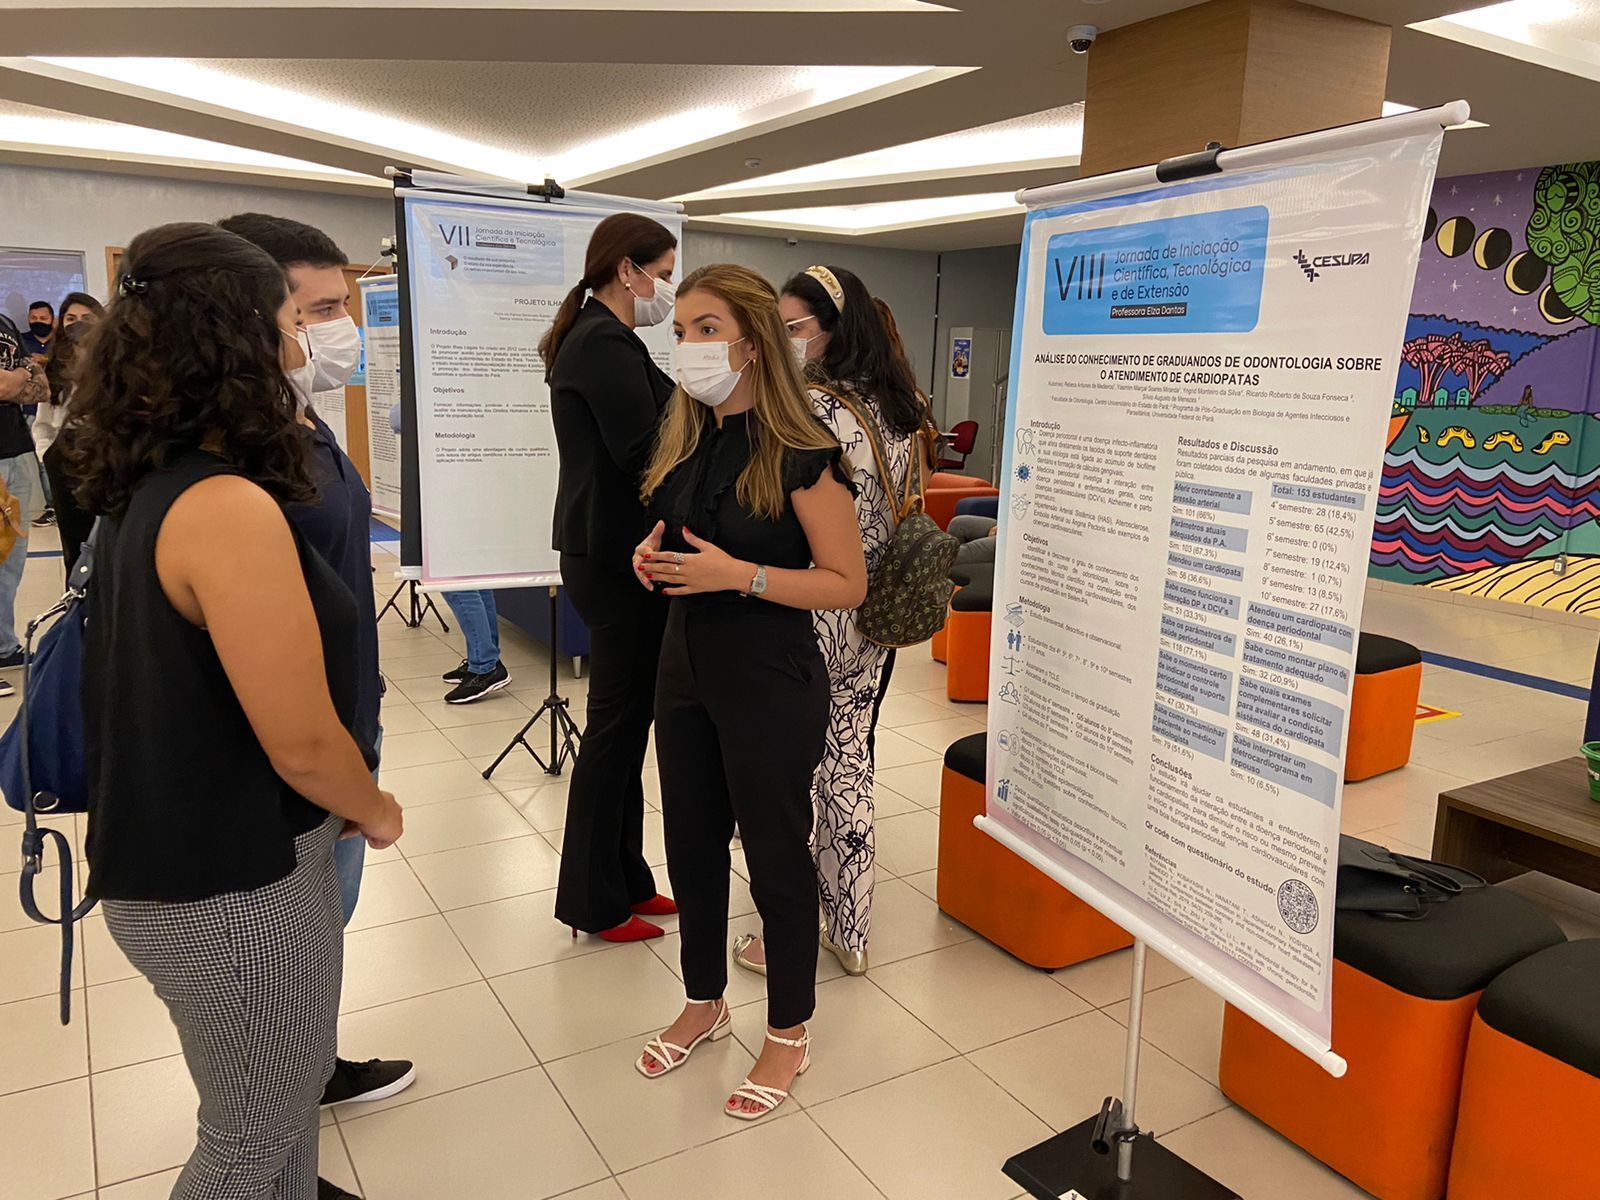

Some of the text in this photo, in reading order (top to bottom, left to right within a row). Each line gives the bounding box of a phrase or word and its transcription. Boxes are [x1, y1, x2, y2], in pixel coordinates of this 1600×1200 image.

[438, 224, 470, 247] VII
[475, 227, 503, 236] Jornada
[514, 229, 545, 239] Iniciação
[475, 234, 509, 243] Científica
[516, 237, 556, 247] Tecnológica
[1115, 238, 1240, 267] Jornada de Iniciação
[1312, 251, 1370, 267] CESUPA
[1173, 258, 1251, 278] Tecnológica
[1056, 254, 1104, 300] VIII
[1121, 286, 1134, 300] de
[1138, 283, 1189, 299] Extensão
[514, 298, 546, 306] PROJETO
[1112, 308, 1146, 316] Professora
[1161, 306, 1185, 315] Dantas
[430, 328, 467, 336] Introdução
[1035, 353, 1382, 371] ANÁLISE DO CONHECIMENTO DE GRADUANDOS DE ODONTOLOGIA SOBRE
[1108, 370, 1168, 382] ATENDIMENTO
[1170, 372, 1182, 383] DE
[1184, 373, 1259, 386] CARDIOPATAS
[432, 386, 465, 394] Objetivos
[1246, 390, 1268, 398] Ricardo
[1269, 391, 1292, 399] Roberto
[1302, 392, 1321, 400] Souza
[1322, 393, 1349, 402] Fonseca
[1252, 409, 1344, 422] Biologia de Agentes Infecciosos
[1031, 420, 1060, 430] Introdução
[435, 432, 476, 440] Metodologia
[1178, 436, 1220, 449] Resultados
[1230, 441, 1278, 455] Discussão
[1209, 453, 1235, 462] parciais
[1236, 455, 1245, 464] da
[1247, 458, 1278, 467] pesquisa
[1354, 469, 1367, 478] que
[1224, 465, 1245, 475] dados
[1248, 468, 1257, 477] de
[1260, 470, 1290, 480] algumas
[1293, 473, 1333, 486] faculdades
[1336, 480, 1366, 490] privadas
[1273, 485, 1355, 504] Total: 153 estudantes
[1279, 504, 1314, 515] semestre:
[1316, 507, 1326, 517] 28
[1277, 520, 1312, 531] semestre:
[1314, 524, 1324, 533] 65
[1023, 533, 1048, 546] Objetivos
[1275, 536, 1310, 548] semestre:
[1273, 551, 1308, 564] semestre:
[1312, 557, 1321, 567] 19
[1271, 566, 1306, 578] semestre:
[1269, 580, 1304, 593] semestre:
[1308, 587, 1317, 596] 13
[1019, 596, 1050, 613] Metodologia
[1272, 596, 1307, 609] semestre:
[1309, 602, 1320, 612] 27
[1247, 616, 1321, 640] doença periodontal
[1248, 604, 1352, 639] Atendeu um cardiopata com
[1246, 628, 1261, 638] Sim:
[1263, 633, 1273, 642] 40
[1243, 653, 1324, 682] tratamento adequado
[1244, 639, 1348, 680] Sabe como montar plano de
[1242, 665, 1257, 676] Sim:
[1259, 670, 1269, 680] 32
[1240, 677, 1311, 707] Sabe quais exames
[1238, 689, 1332, 726] complementares solicitar
[1237, 698, 1253, 711] para
[1255, 707, 1280, 720] avaliar
[1288, 719, 1323, 735] condição
[1235, 722, 1249, 734] Sim:
[1251, 729, 1261, 738] 48
[1236, 712, 1324, 748] sistêmica do cardiopata
[1233, 733, 1306, 769] Sabe interpretar um
[1151, 754, 1192, 780] Conclusões
[1231, 758, 1260, 774] repouso
[1232, 746, 1312, 783] eletrocardiograma em
[1230, 769, 1244, 781] Sim:
[1247, 776, 1256, 785] 10
[1278, 824, 1320, 848] entenderem
[1154, 827, 1170, 840] code
[1171, 836, 1186, 848] com
[1187, 845, 1233, 872] questionário
[1234, 868, 1245, 879] do
[1246, 876, 1276, 896] estudo:
[1221, 831, 1325, 888] doenças cardiovasculares com
